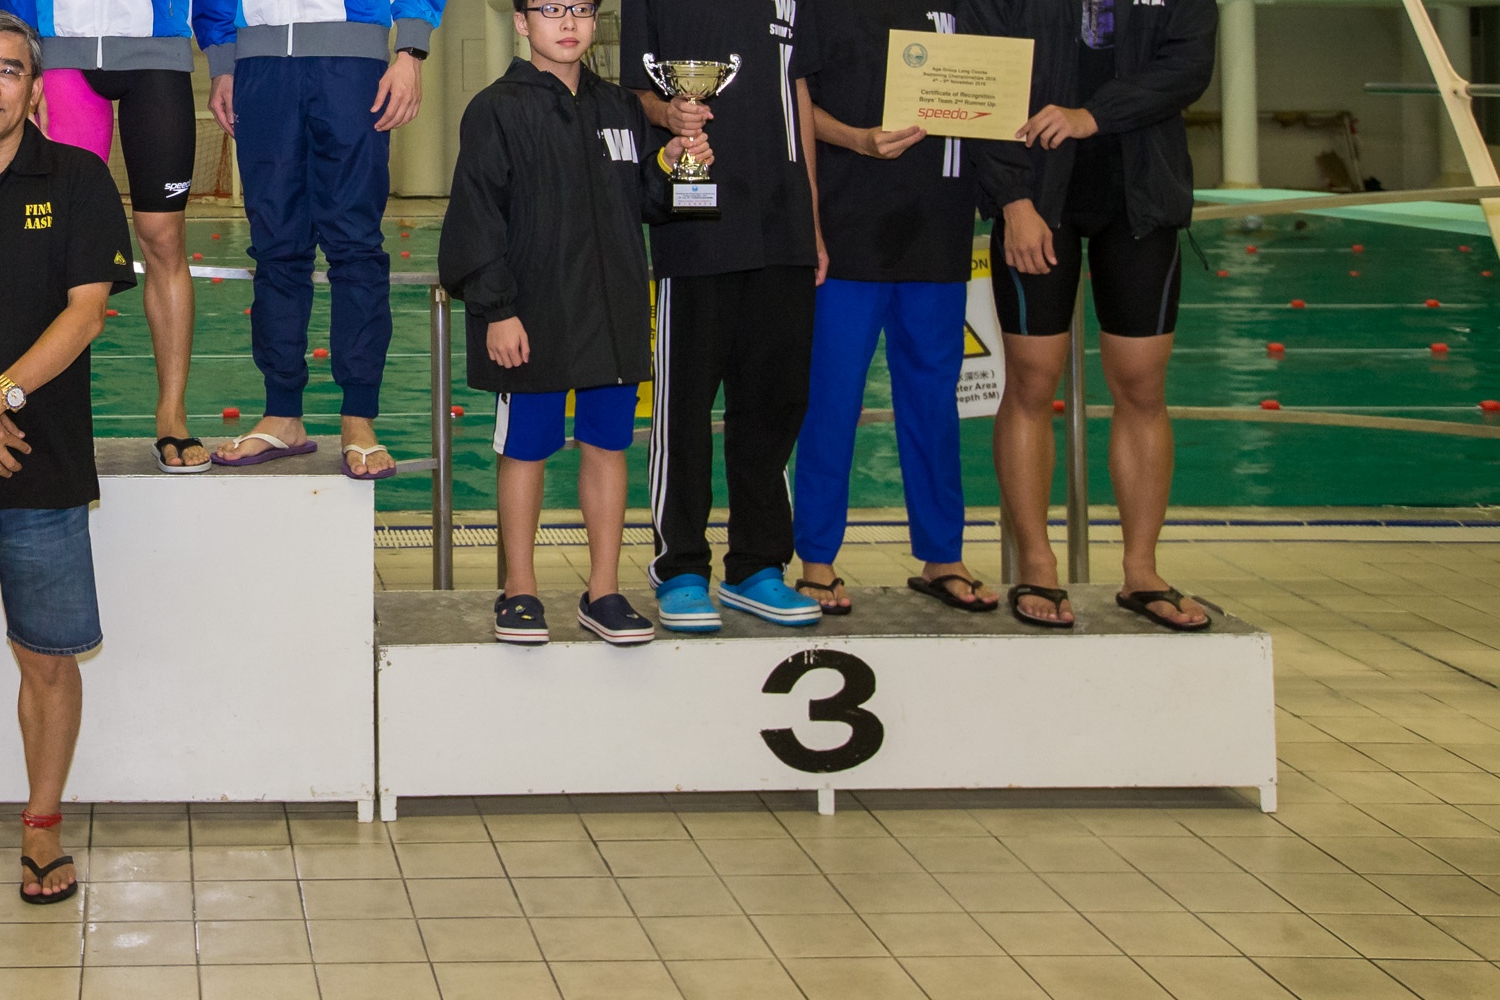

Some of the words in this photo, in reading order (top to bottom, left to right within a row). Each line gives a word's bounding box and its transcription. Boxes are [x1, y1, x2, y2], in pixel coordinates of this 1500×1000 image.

[920, 89, 952, 97] Certificate
[959, 91, 996, 100] Recognition
[964, 99, 986, 107] Runner
[917, 107, 969, 120] speedo
[24, 201, 52, 216] FINA
[974, 381, 998, 391] Area
[759, 649, 884, 774] 3
